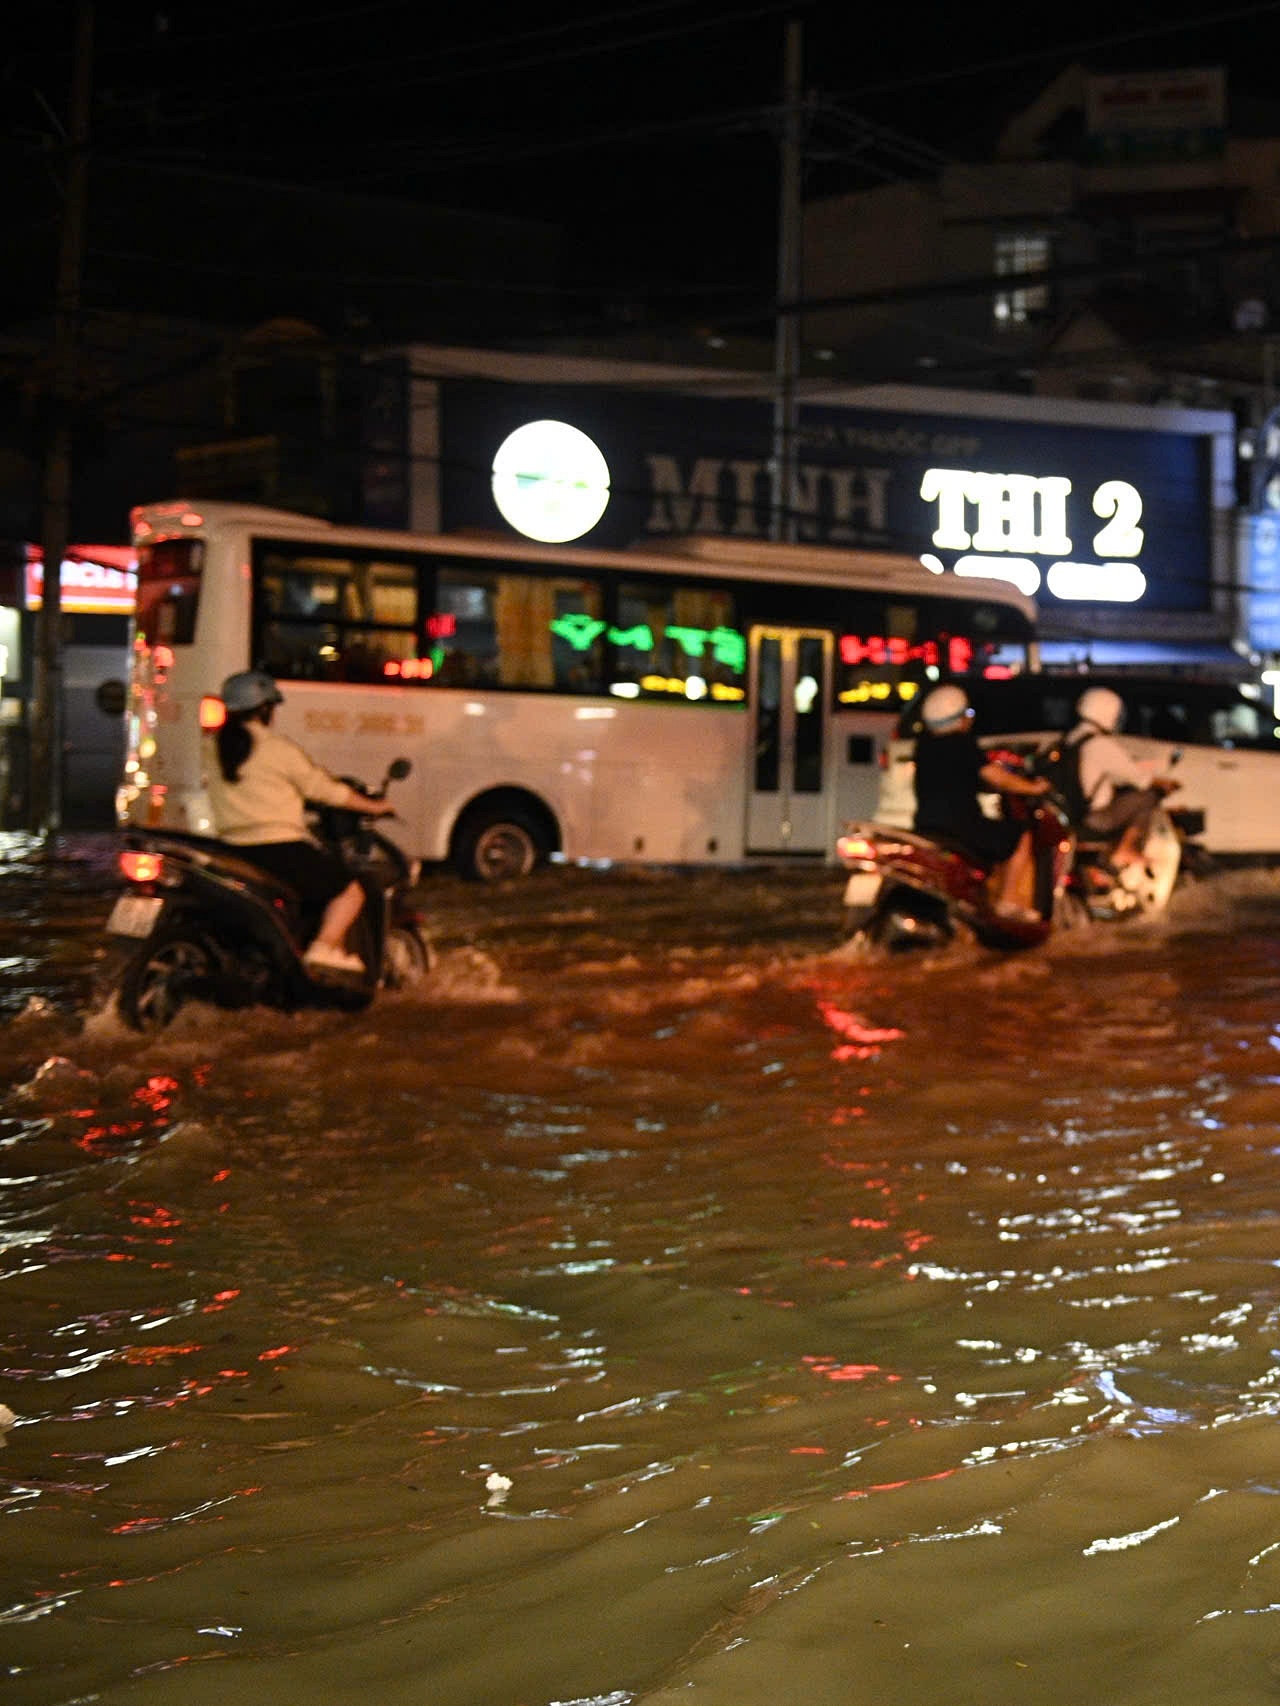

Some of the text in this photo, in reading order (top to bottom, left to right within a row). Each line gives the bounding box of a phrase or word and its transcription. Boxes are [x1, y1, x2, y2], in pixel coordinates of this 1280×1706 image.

[644, 453, 1145, 558] MINH THI 2
